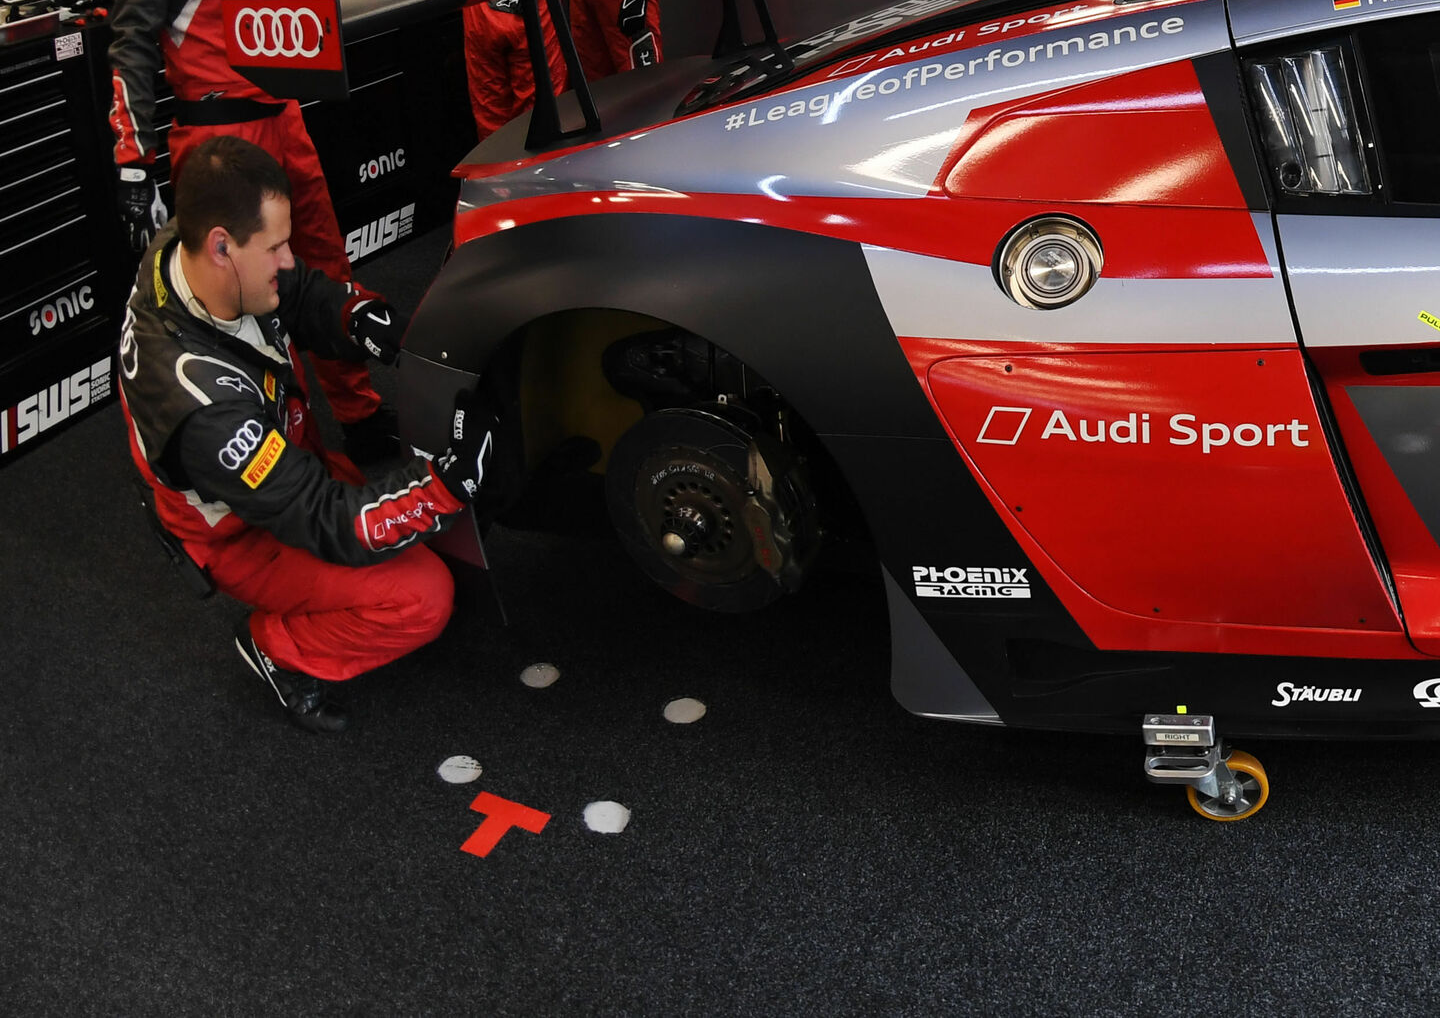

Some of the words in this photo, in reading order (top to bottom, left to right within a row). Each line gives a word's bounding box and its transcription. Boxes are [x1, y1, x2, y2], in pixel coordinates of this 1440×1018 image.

[877, 31, 966, 62] Audi
[977, 3, 1089, 36] Sport
[724, 13, 1185, 131] #LeagueofPerformance
[359, 148, 406, 183] SONIC
[345, 209, 400, 264] SWS
[29, 285, 95, 336] SONIC
[17, 366, 91, 445] SWS
[1040, 410, 1151, 445] Audi
[1168, 413, 1310, 454] Sport
[247, 436, 282, 485] PIRELLI
[385, 513, 409, 530] Aud
[912, 565, 1029, 584] PHOENIX
[932, 584, 1013, 597] RACING
[1271, 681, 1362, 707] STÄUBLI
[1164, 733, 1191, 741] RIGHT
